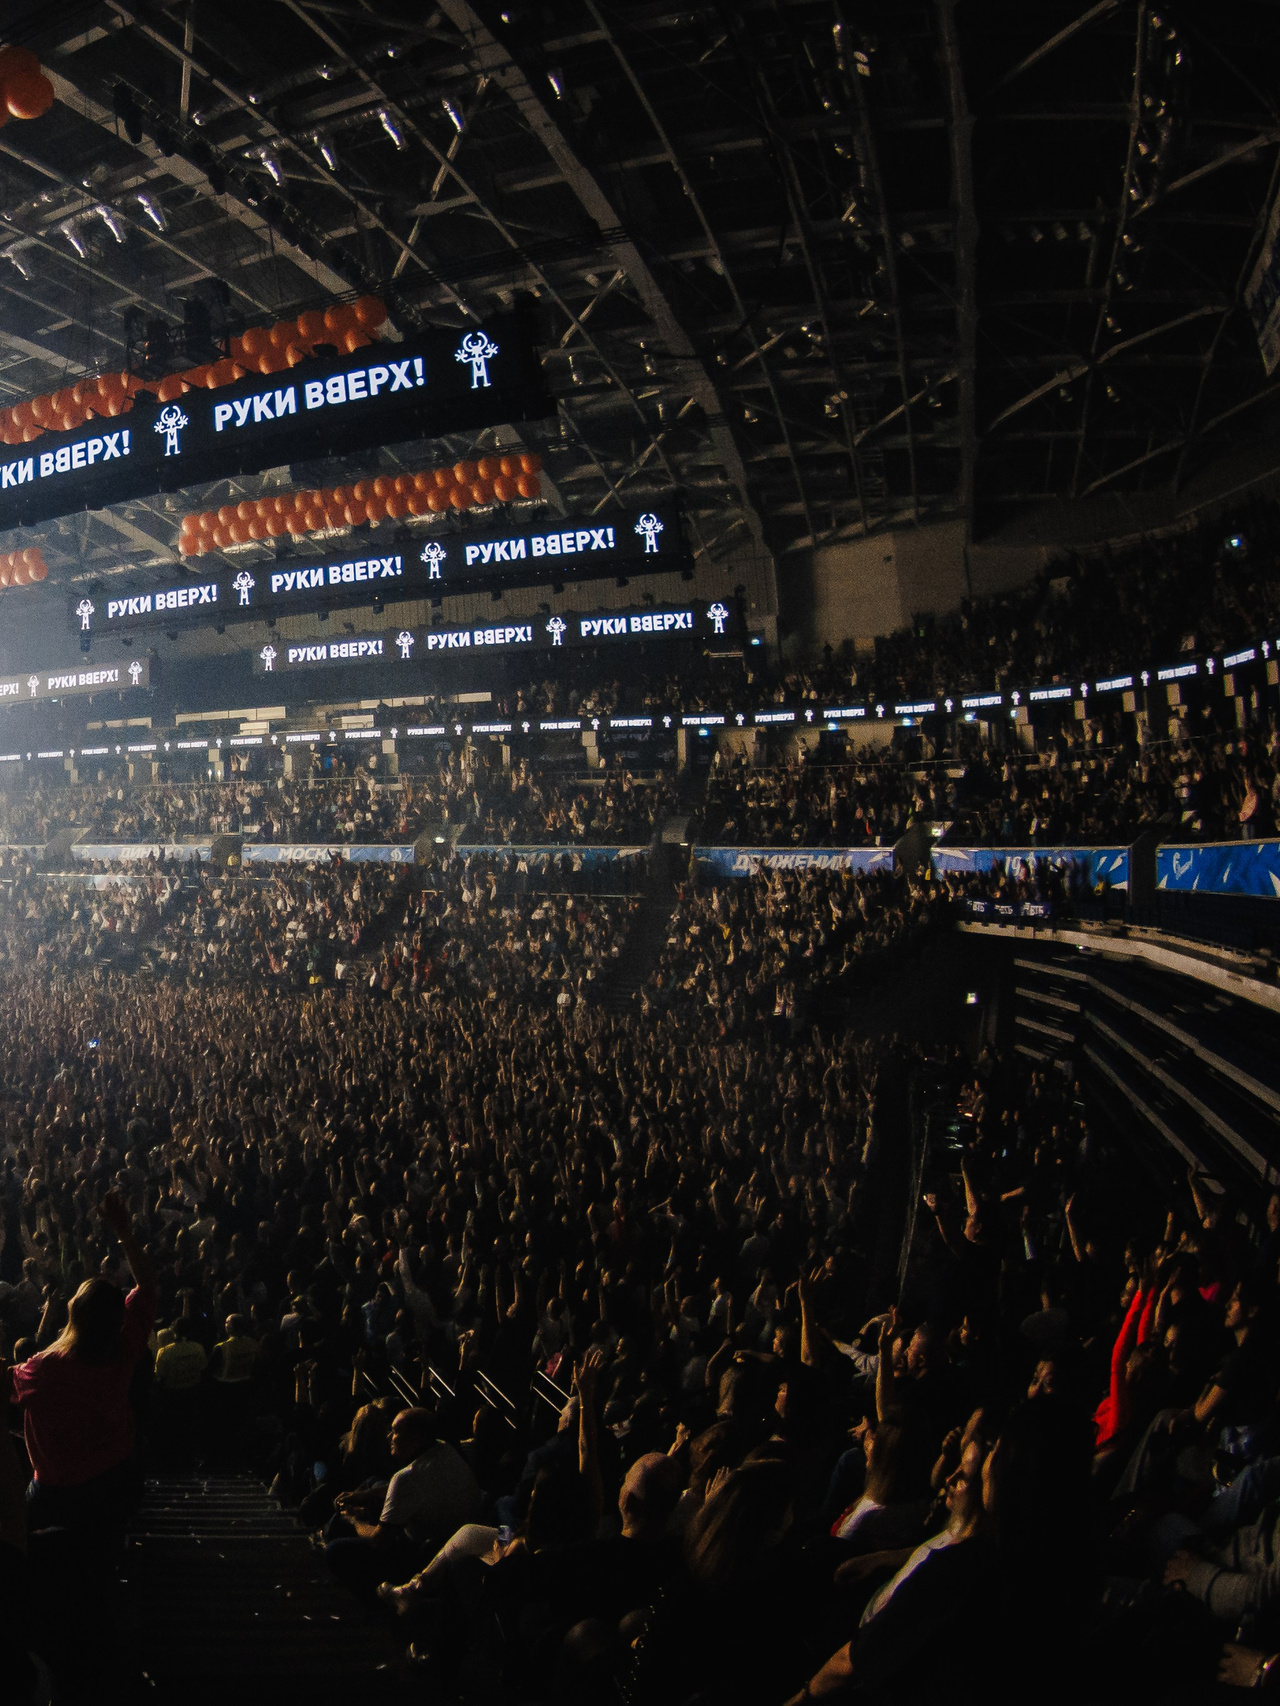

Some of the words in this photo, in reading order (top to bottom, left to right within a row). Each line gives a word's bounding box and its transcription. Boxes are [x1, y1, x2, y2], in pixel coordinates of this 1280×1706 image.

[213, 386, 297, 432] РУКИ
[305, 357, 425, 409] ВВЕРХ!
[39, 429, 131, 478] ВВЕРХ!
[465, 538, 526, 566] РУКИ
[531, 527, 615, 557] ВВЕРХ!
[271, 569, 324, 593] РУКИ
[328, 556, 403, 584] ВВЕРХ!
[107, 595, 151, 618] РУКИ
[155, 584, 218, 610] ВВЕРХ!
[427, 634, 471, 650] РУКИ
[473, 626, 532, 645] ВВЕРХ!
[580, 618, 627, 637] РУКИ
[630, 612, 693, 633] ВВЕРХ!
[288, 647, 326, 663] РУКИ
[329, 640, 383, 659] ВВЕРХ!
[47, 676, 76, 690] РУКИ
